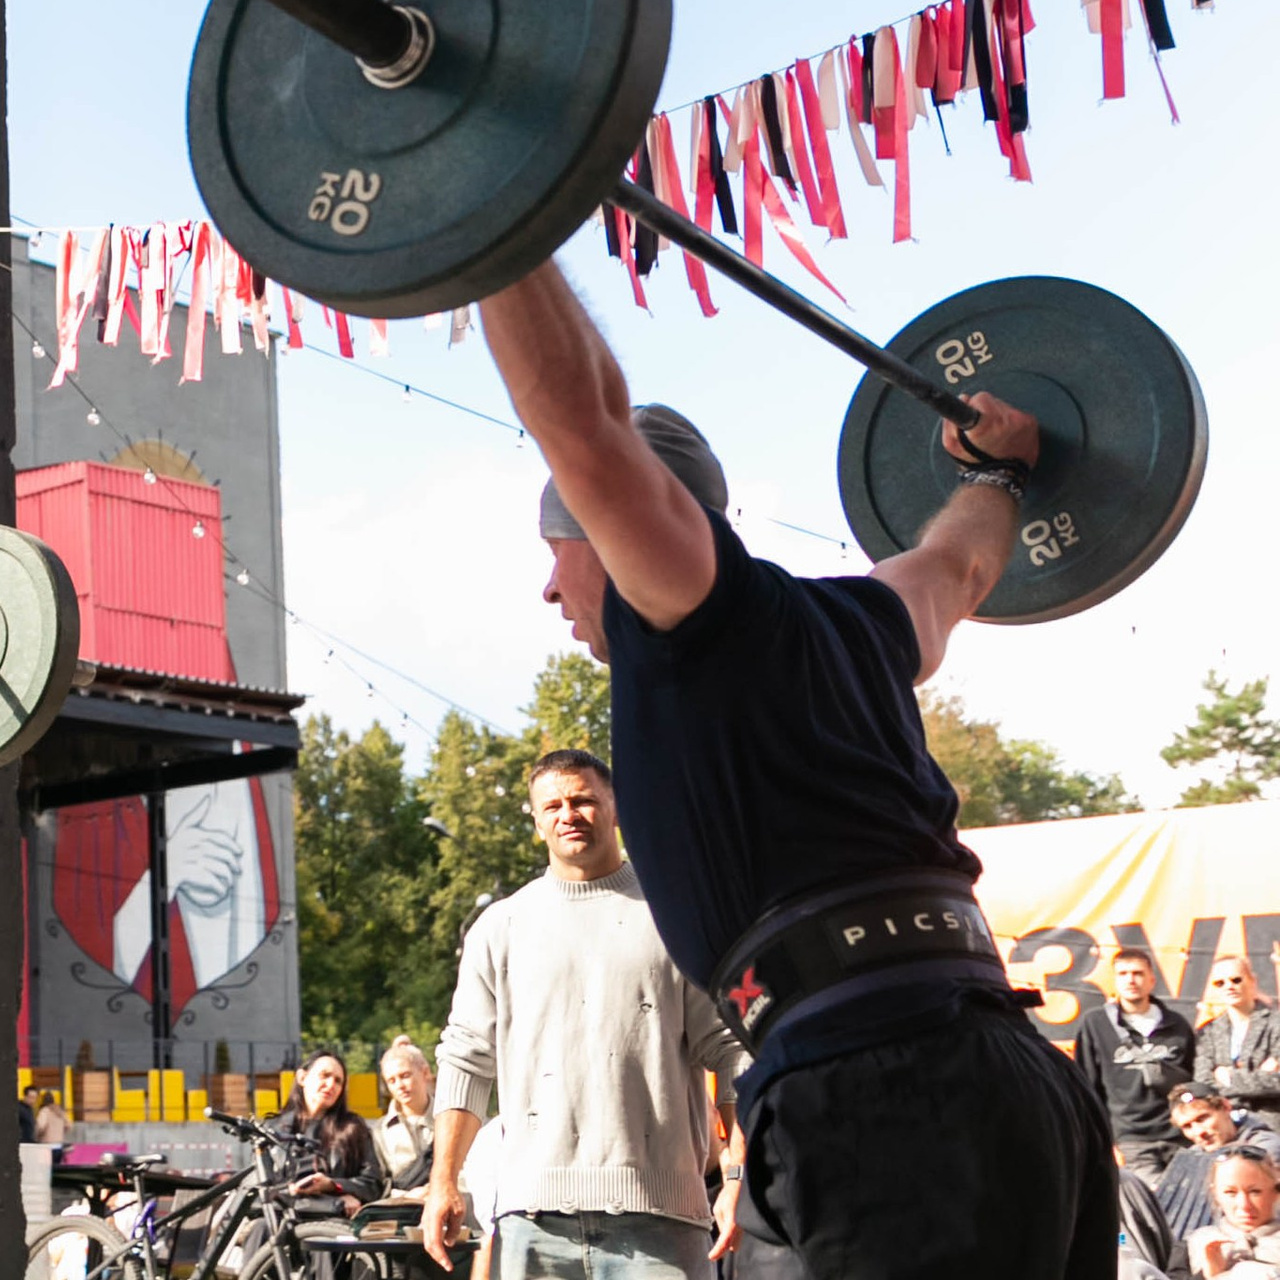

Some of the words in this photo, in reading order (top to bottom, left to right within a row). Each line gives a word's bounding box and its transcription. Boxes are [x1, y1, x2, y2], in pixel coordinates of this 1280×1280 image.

[307, 171, 340, 221] KG
[331, 168, 380, 236] 20
[935, 338, 976, 384] 20
[966, 330, 994, 365] KG
[1021, 520, 1062, 567] 20
[1052, 511, 1080, 547] KG
